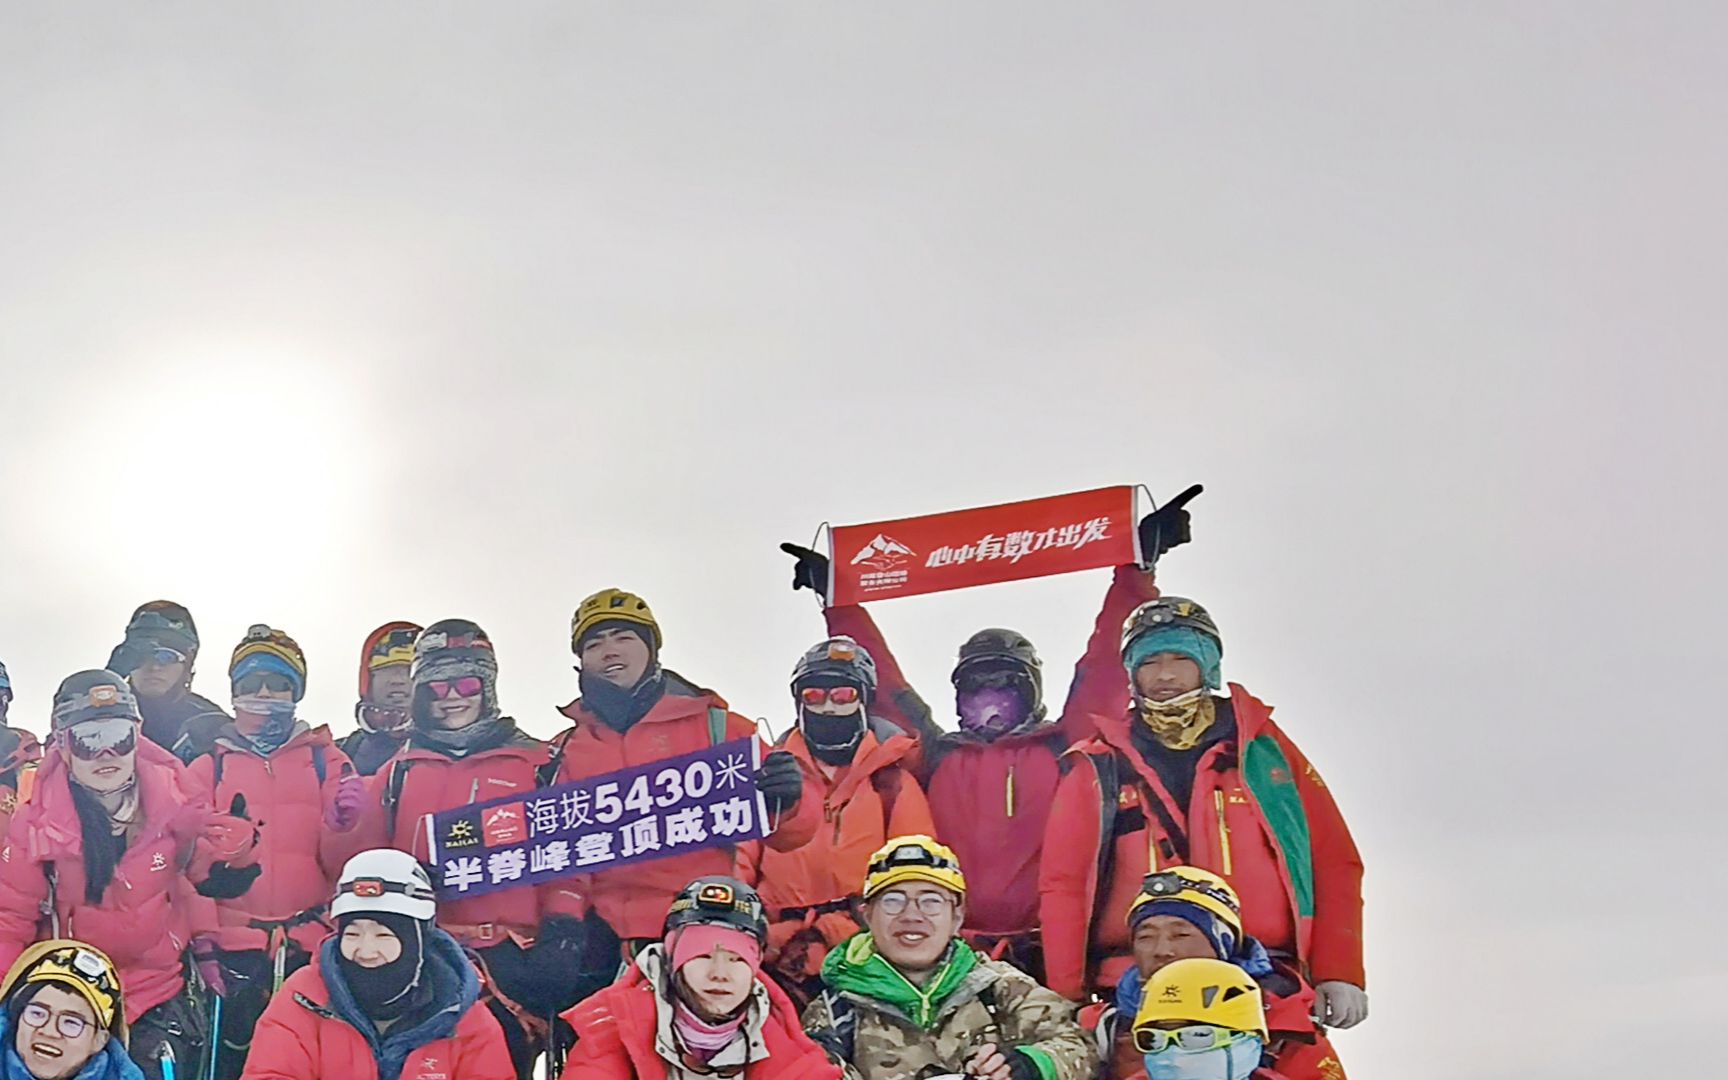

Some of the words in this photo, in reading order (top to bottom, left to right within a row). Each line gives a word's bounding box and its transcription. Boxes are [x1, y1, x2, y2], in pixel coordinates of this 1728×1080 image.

[925, 516, 1112, 569] 心中有数才出发
[526, 753, 749, 838] 海拔5430米
[444, 796, 753, 892] 半脊峰登顶成功
